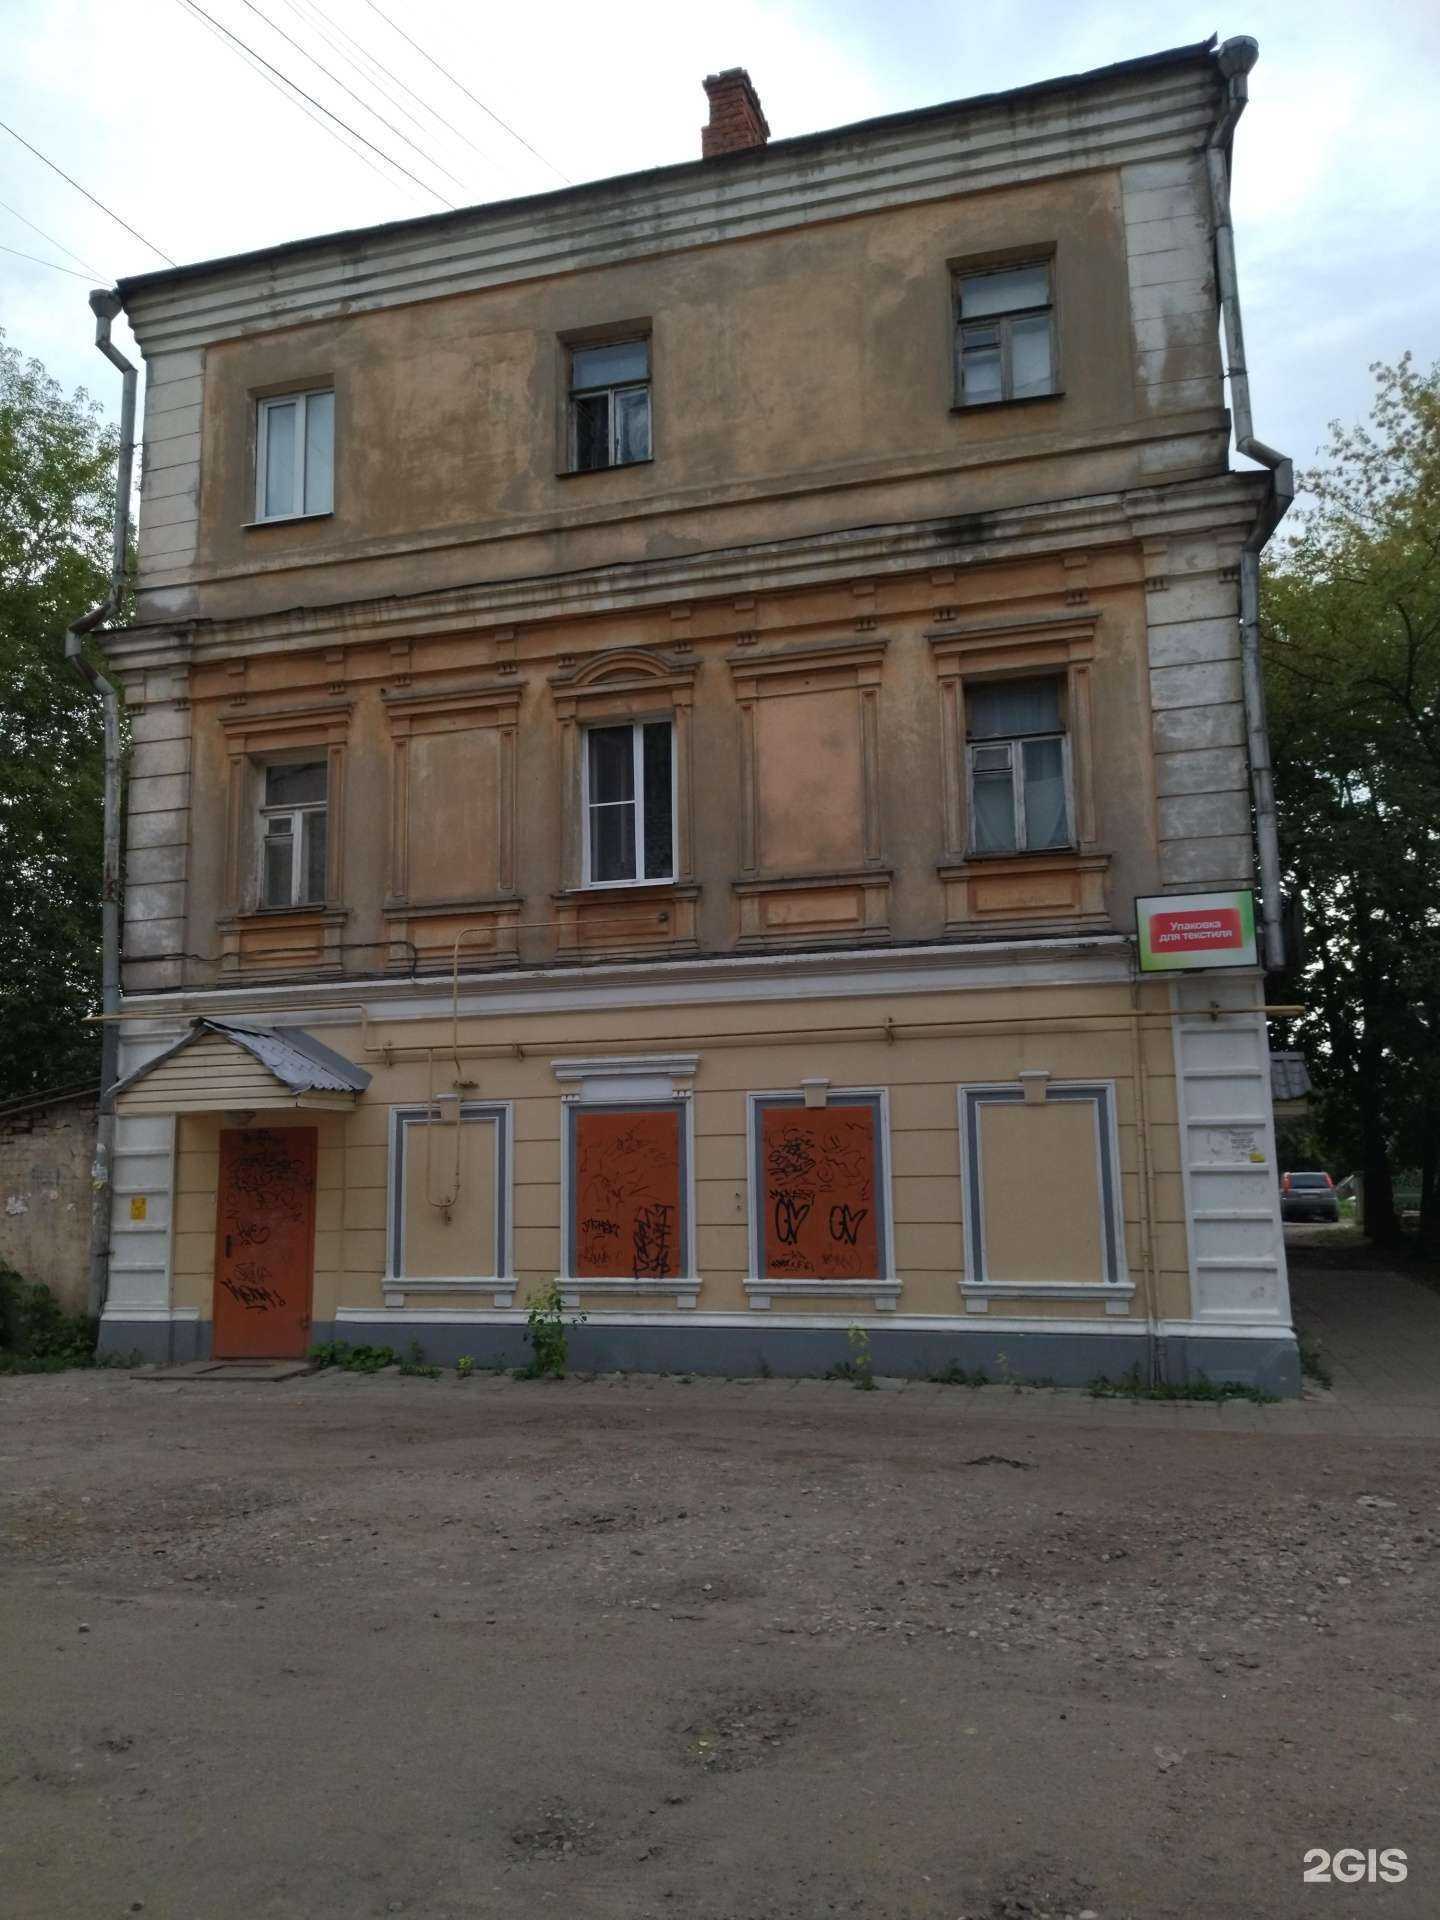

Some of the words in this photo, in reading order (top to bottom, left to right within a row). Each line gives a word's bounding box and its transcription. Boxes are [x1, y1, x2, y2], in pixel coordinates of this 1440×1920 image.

[1170, 921, 1221, 931] Упаковка
[1159, 932, 1181, 943] для
[1183, 930, 1232, 940] текстиля
